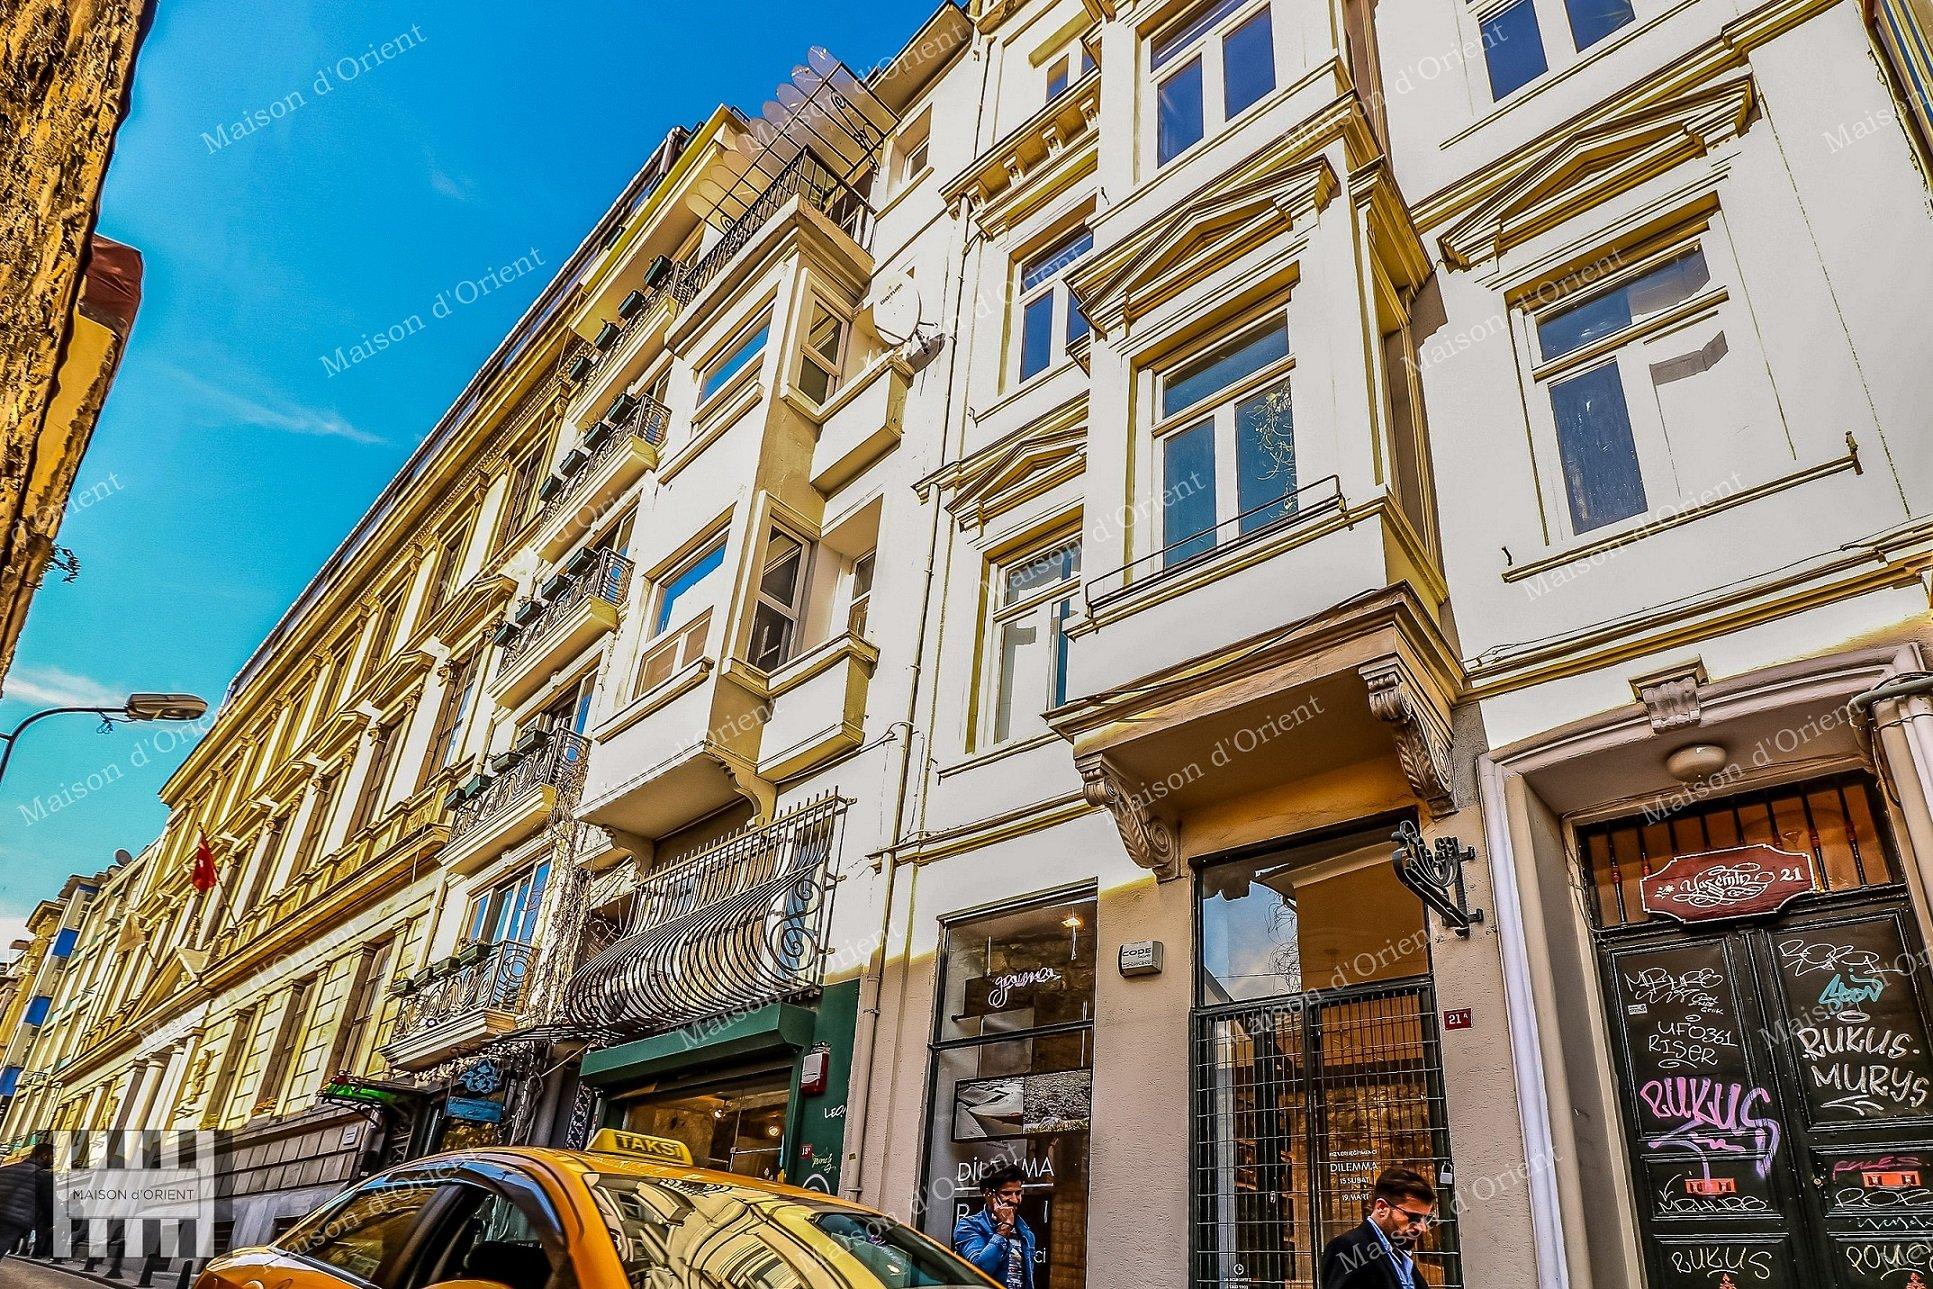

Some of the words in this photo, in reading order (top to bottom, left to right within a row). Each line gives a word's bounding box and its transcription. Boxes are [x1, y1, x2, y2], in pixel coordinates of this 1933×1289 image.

[1779, 866, 1804, 882] 21
[1122, 947, 1152, 957] CODE
[957, 1156, 1055, 1182] DİLMA
